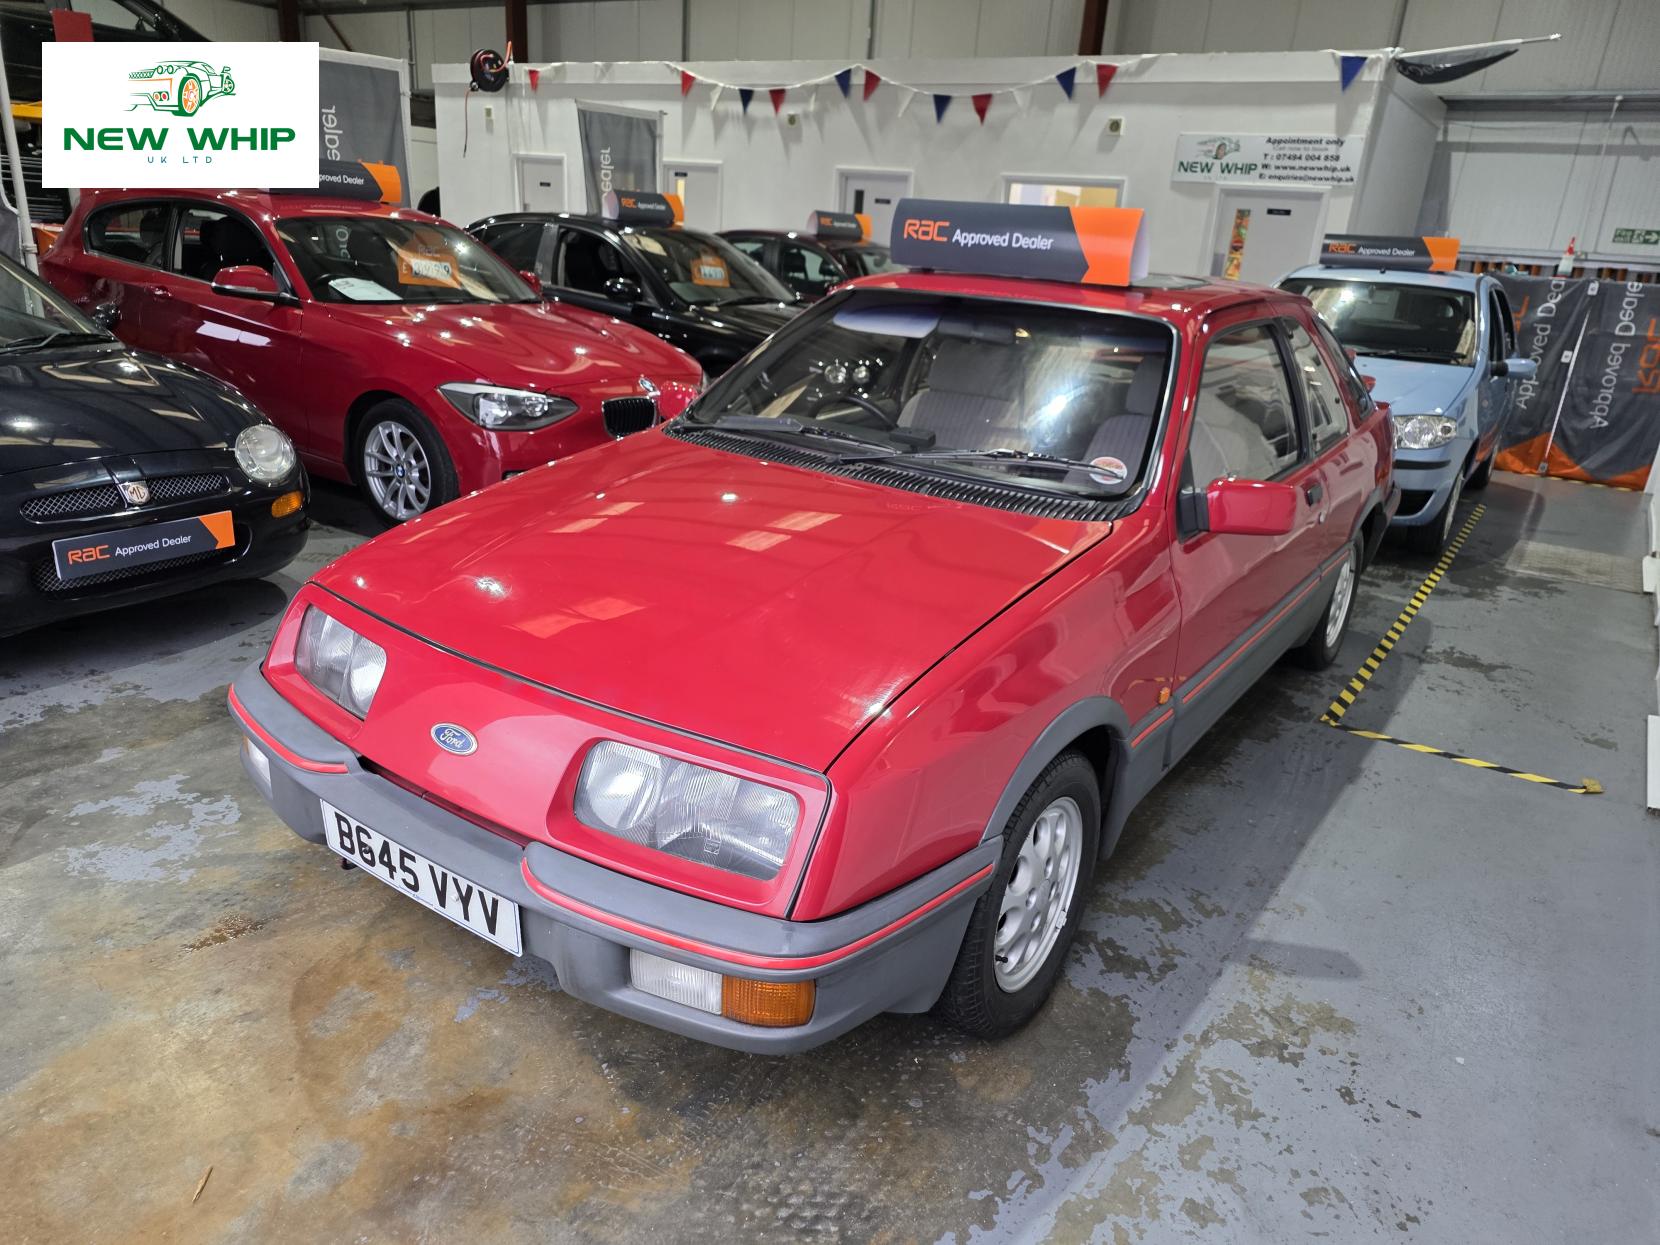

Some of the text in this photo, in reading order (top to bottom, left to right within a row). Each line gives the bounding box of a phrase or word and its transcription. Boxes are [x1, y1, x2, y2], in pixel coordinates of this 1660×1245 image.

[1266, 137, 1344, 147] Appointment only
[1178, 161, 1258, 175] NEW WHIP
[319, 174, 364, 185] proved Dealer
[952, 228, 1009, 248] Approved
[1011, 232, 1054, 250] Dealer
[1358, 246, 1391, 256] Approved
[1391, 248, 1415, 256] Dealer
[1516, 323, 1551, 409] Appoved
[115, 539, 160, 557] Approved
[162, 534, 192, 548] Dealer
[439, 728, 463, 749] Ford
[334, 811, 499, 937] B645 VYV
